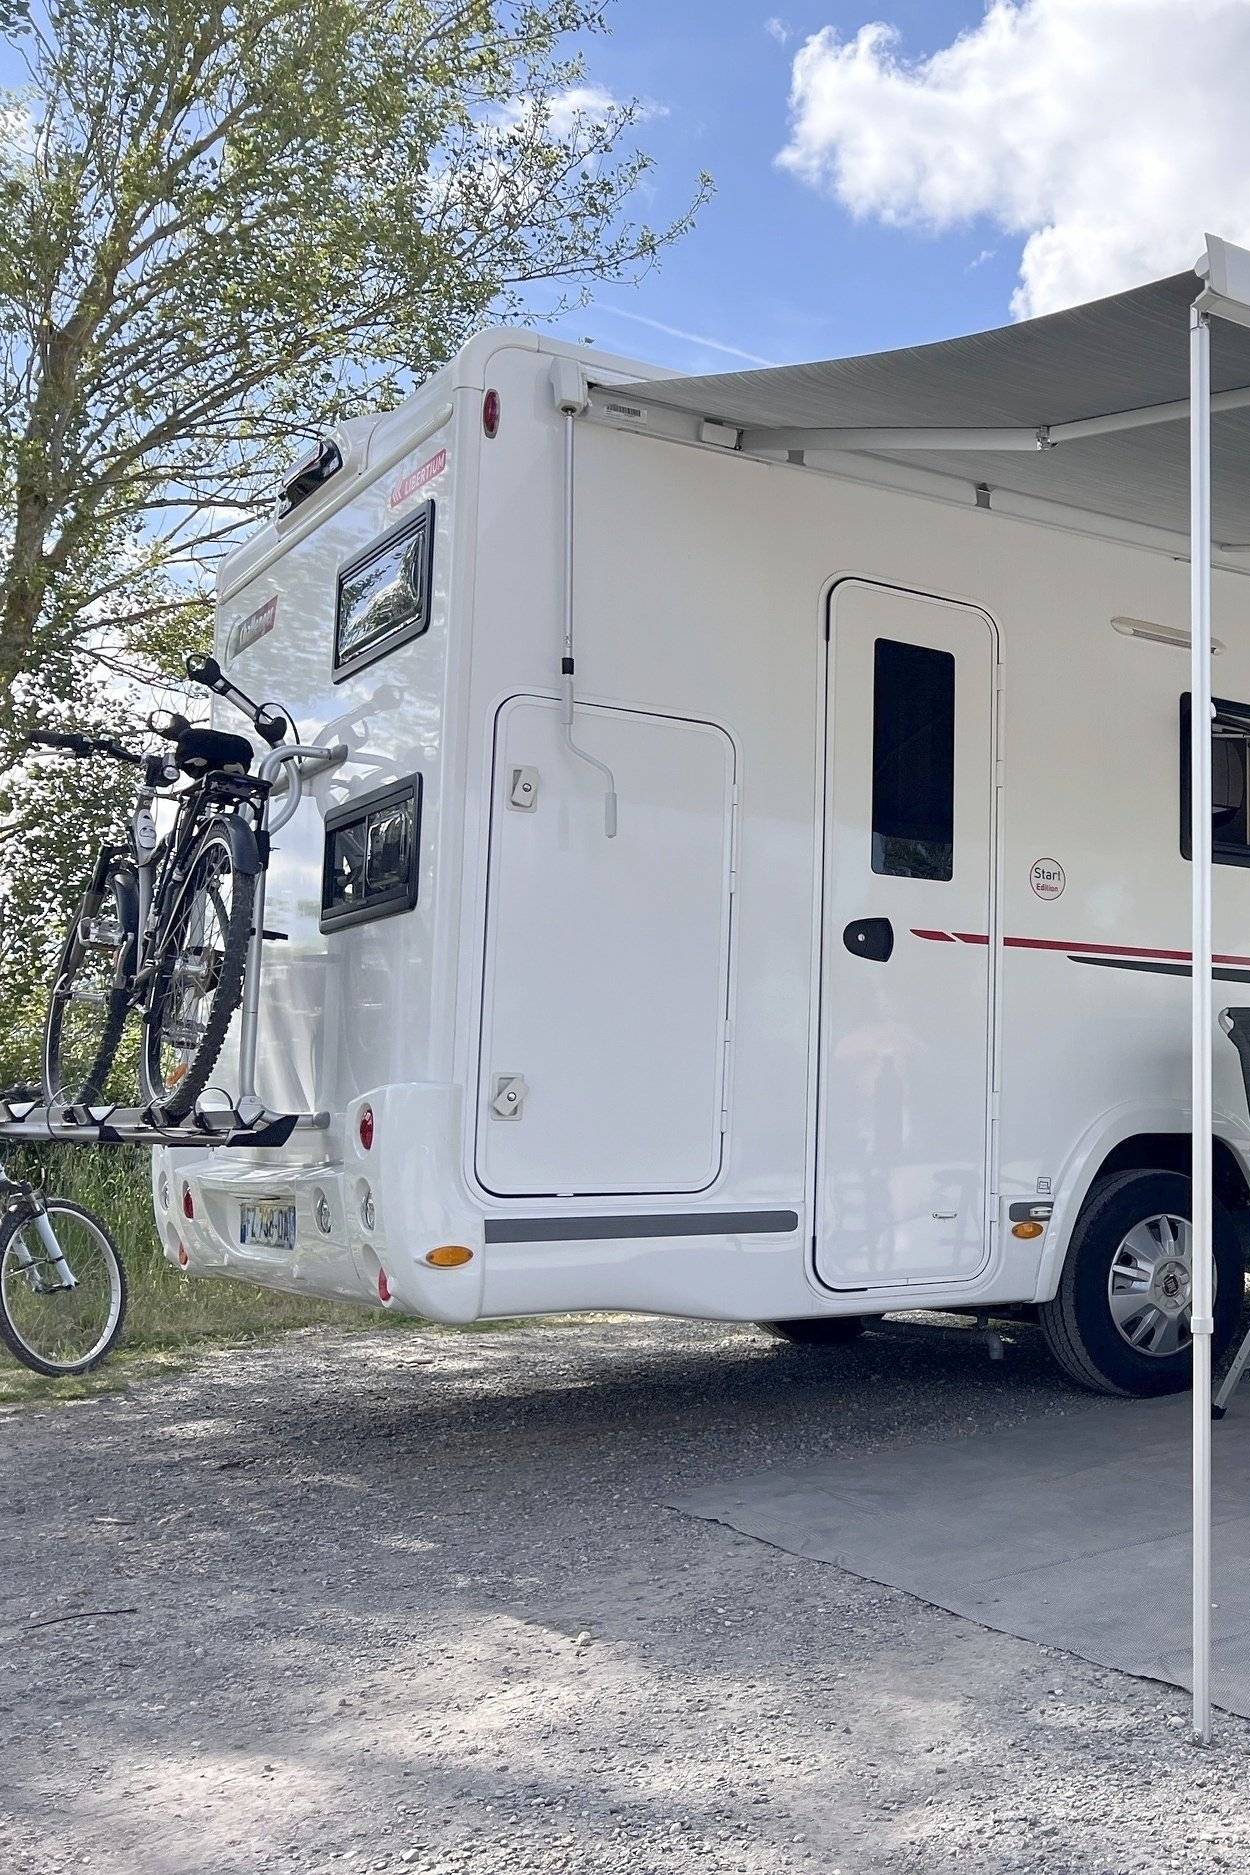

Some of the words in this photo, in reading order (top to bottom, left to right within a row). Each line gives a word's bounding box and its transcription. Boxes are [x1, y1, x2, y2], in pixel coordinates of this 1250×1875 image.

[404, 451, 445, 495] LIBERTIUM
[1034, 867, 1061, 881] Start
[1036, 883, 1059, 892] Edition
